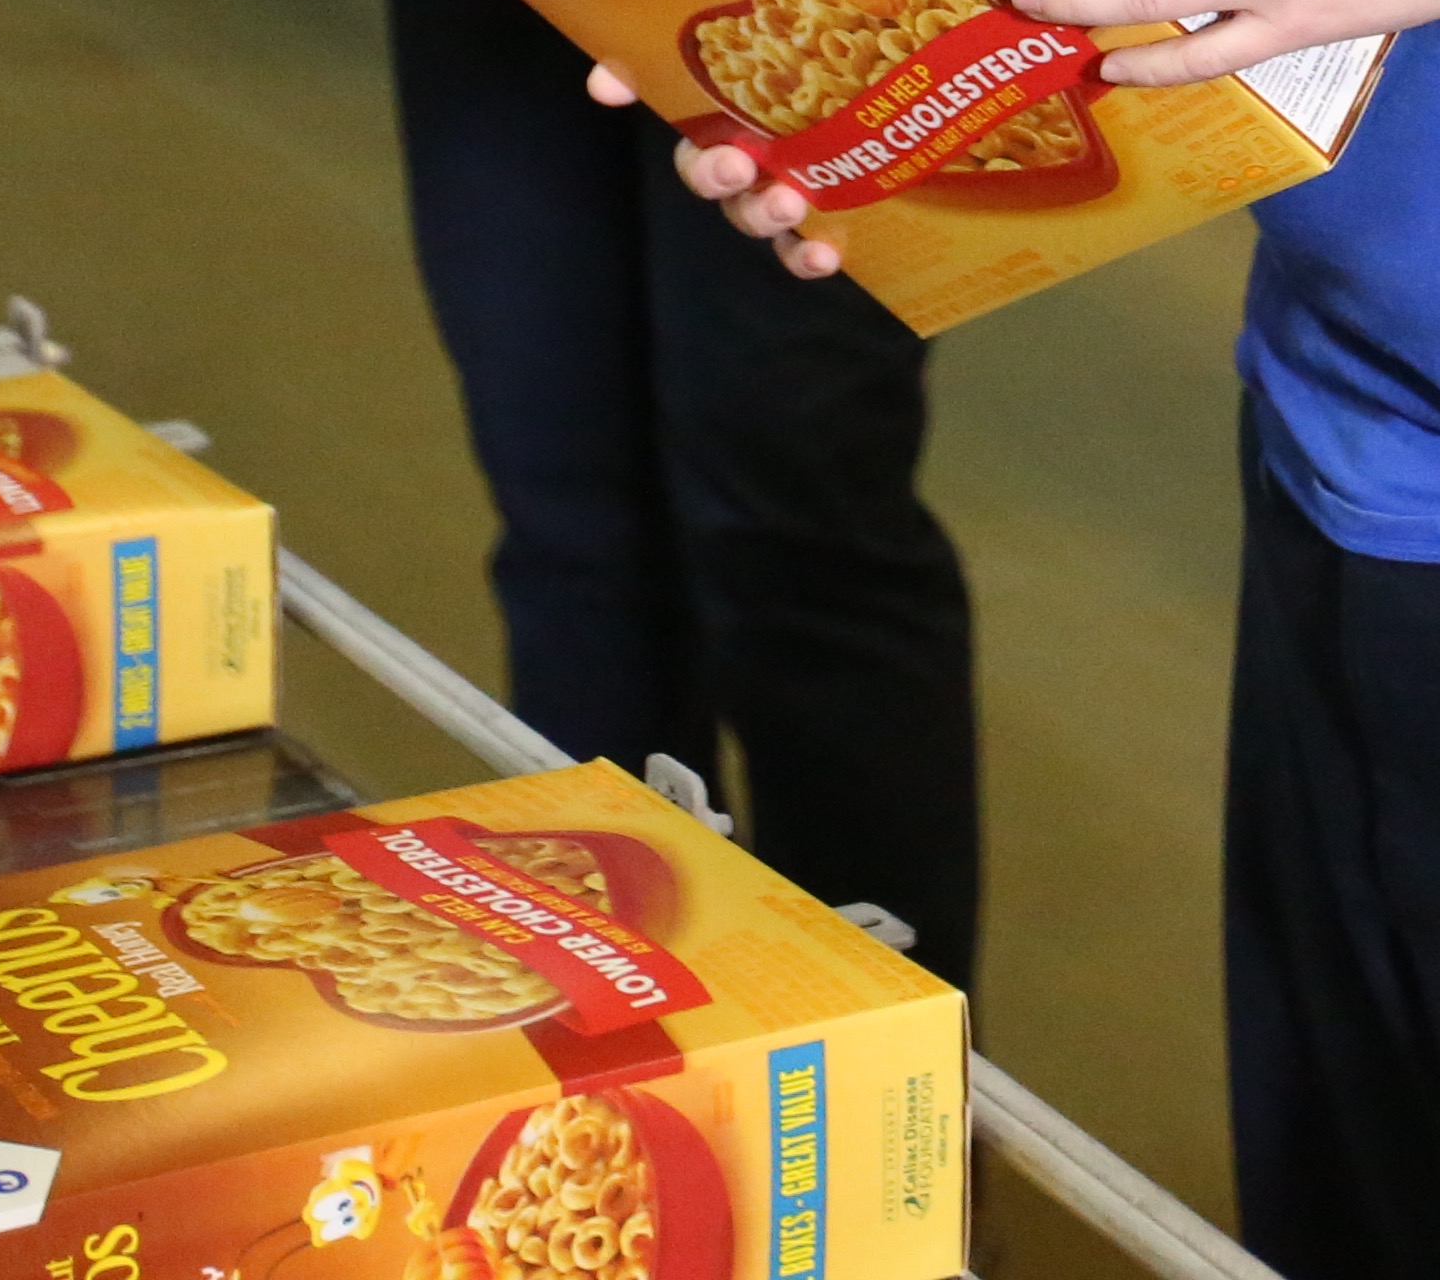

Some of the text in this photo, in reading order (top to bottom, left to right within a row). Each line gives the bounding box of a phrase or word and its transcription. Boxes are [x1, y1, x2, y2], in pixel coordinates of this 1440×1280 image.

[788, 138, 898, 191] LOWER
[883, 32, 1078, 151] CHOLESTEROL
[855, 63, 934, 130] CAN HELP
[932, 127, 961, 156] HEART
[958, 98, 1006, 135] HEALTHY
[1001, 83, 1028, 109] DIET
[376, 829, 573, 935] CHOLESTEROL
[420, 893, 536, 945] CAN HELP
[90, 920, 206, 999] Real Honey
[557, 931, 667, 1009] LOWER
[778, 1065, 818, 1277] BOXES GREAT VALUE
[904, 1077, 919, 1194] Celiac Disease
[918, 1071, 934, 1188] FOUNDATION
